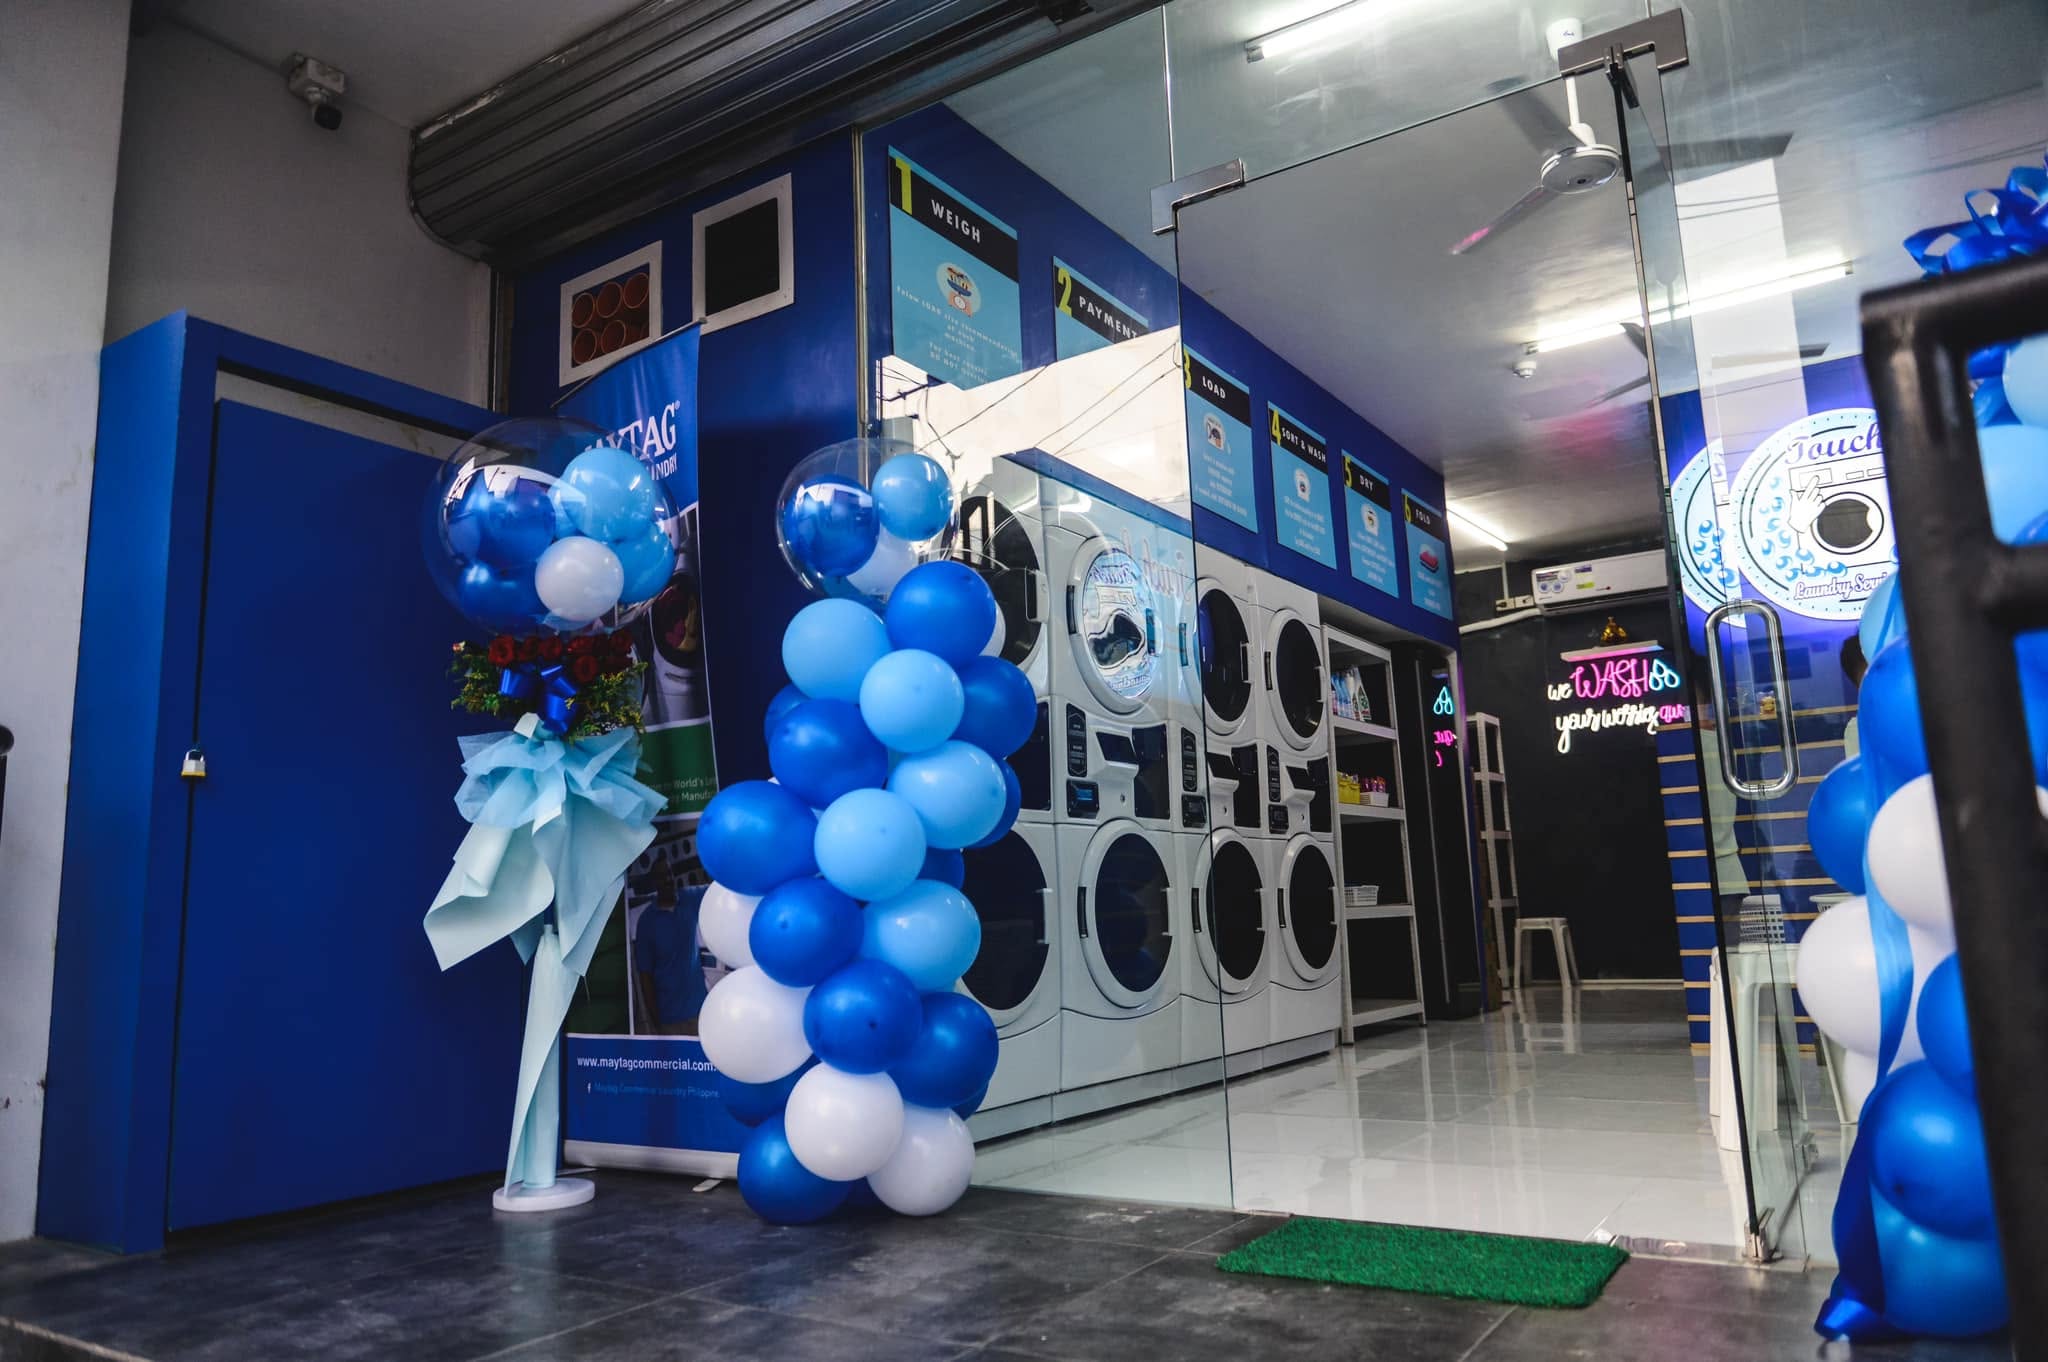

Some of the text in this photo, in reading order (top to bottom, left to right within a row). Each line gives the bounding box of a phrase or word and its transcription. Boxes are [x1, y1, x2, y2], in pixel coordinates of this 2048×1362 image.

[895, 157, 981, 244] 1 WEIGH
[1057, 267, 1137, 341] 2 PAYMENT
[1183, 346, 1226, 399] 3 LOAD
[1271, 408, 1327, 464] 4 SORT & WASH
[1784, 421, 1883, 466] Touch
[1344, 454, 1374, 492] 5 DRY
[1404, 493, 1431, 526] 6 FOLD
[1793, 576, 1853, 600] Laundry
[1547, 658, 1649, 701] we WASH
[1555, 706, 1600, 754] your
[577, 1057, 718, 1072] www.maytagcommercial.com.
